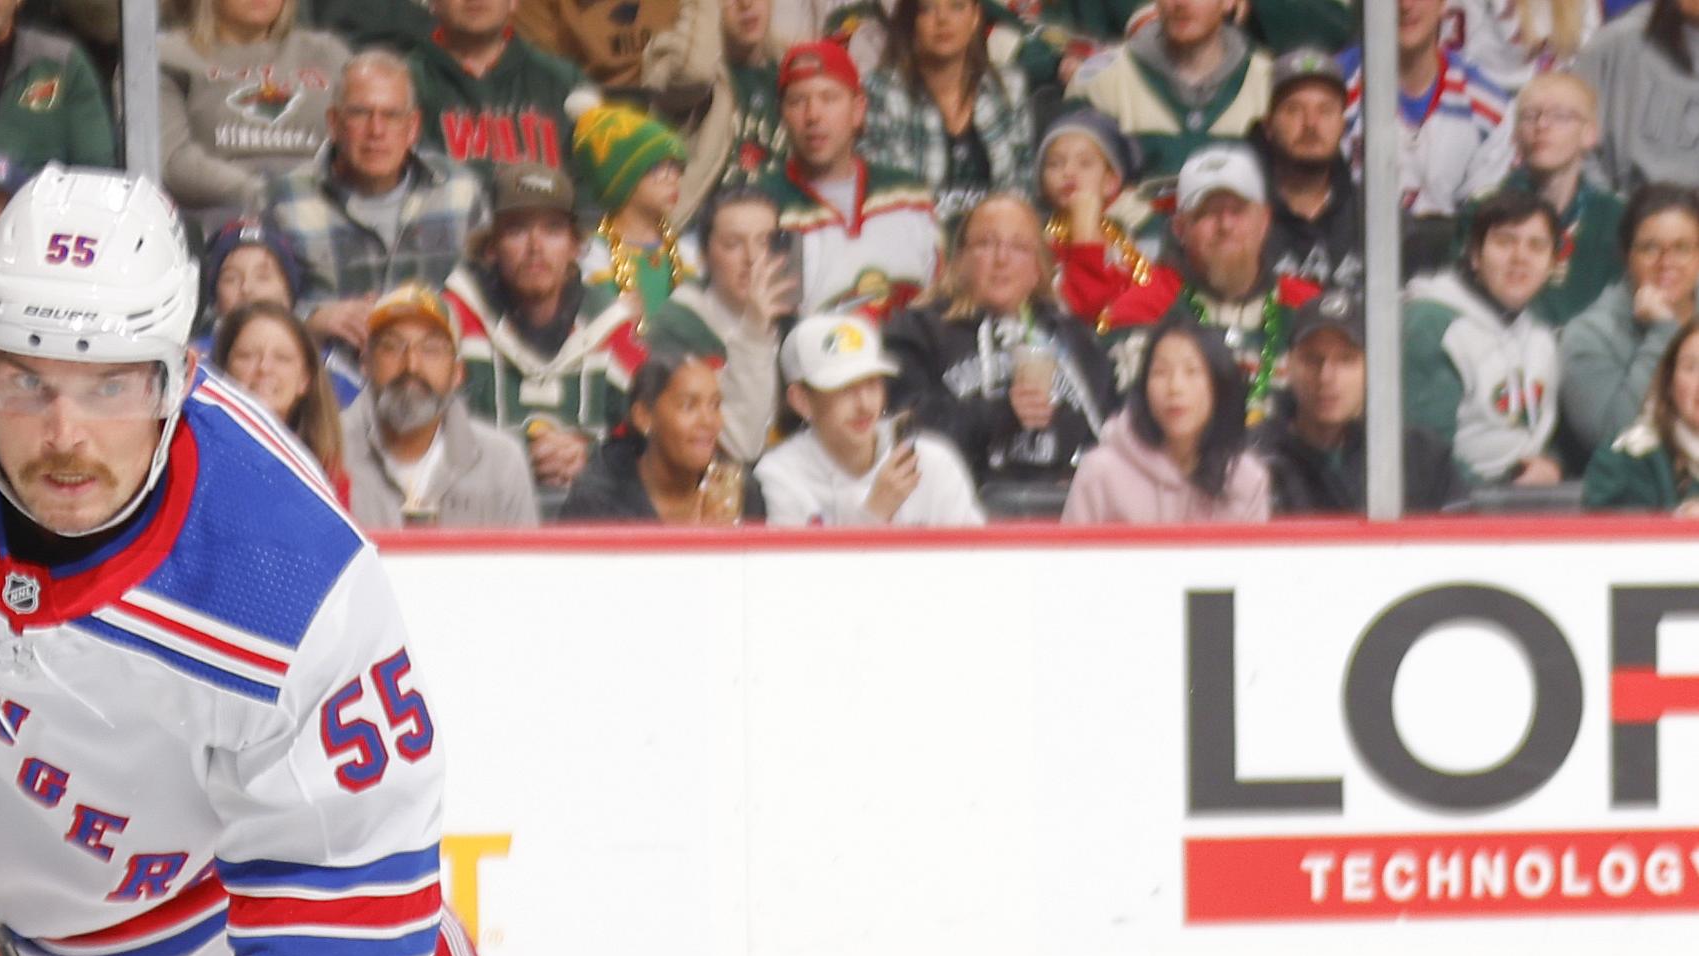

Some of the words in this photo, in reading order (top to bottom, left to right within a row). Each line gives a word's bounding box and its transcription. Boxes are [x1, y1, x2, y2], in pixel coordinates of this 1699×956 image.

[45, 232, 98, 268] 55
[23, 305, 98, 321] BAUER
[319, 645, 434, 794] 55
[1300, 846, 1699, 903] TECHNOLOG
